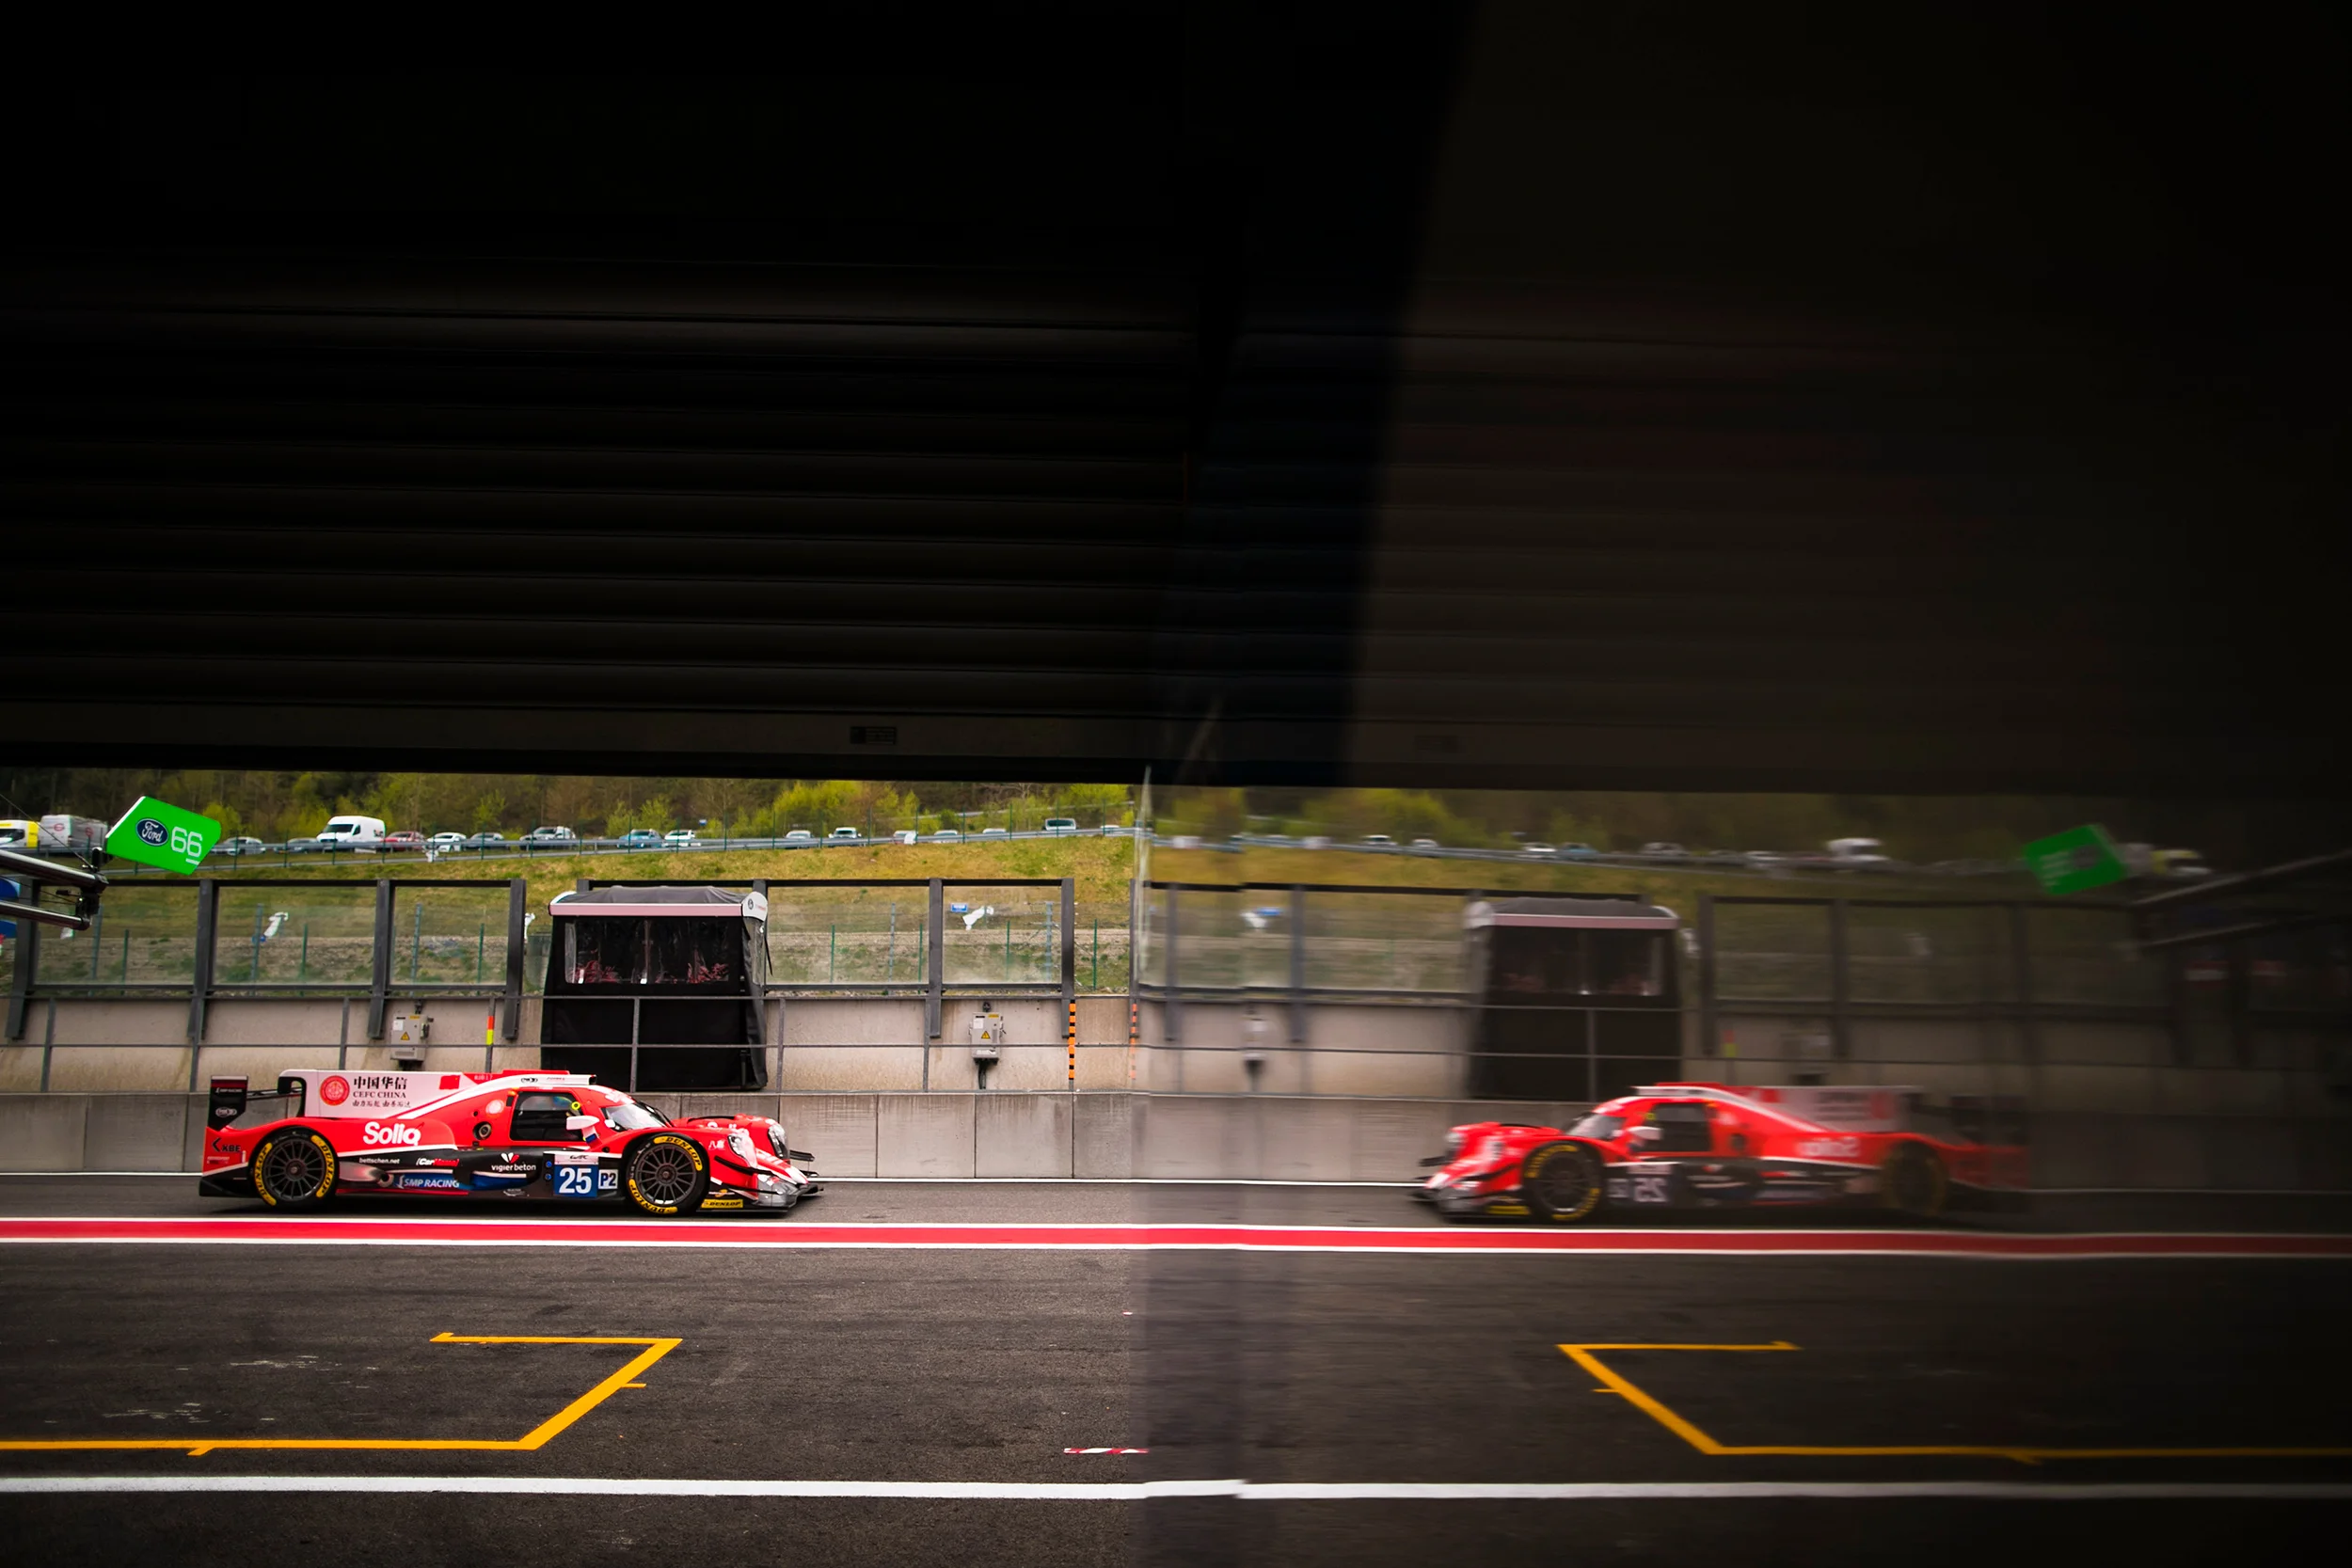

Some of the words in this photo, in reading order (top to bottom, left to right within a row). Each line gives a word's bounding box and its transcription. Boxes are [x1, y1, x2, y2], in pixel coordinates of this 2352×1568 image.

[171, 826, 203, 857] 66
[352, 1090, 376, 1099] CEFC
[354, 1075, 407, 1090] 中国华信
[665, 1136, 701, 1166] DUNLOP
[321, 1144, 335, 1196] DUNLOP
[404, 1178, 424, 1187] SMP
[423, 1179, 460, 1188] RACING
[559, 1167, 592, 1195] 25
[600, 1173, 616, 1187] P2
[630, 1183, 666, 1213] DUNLOP
